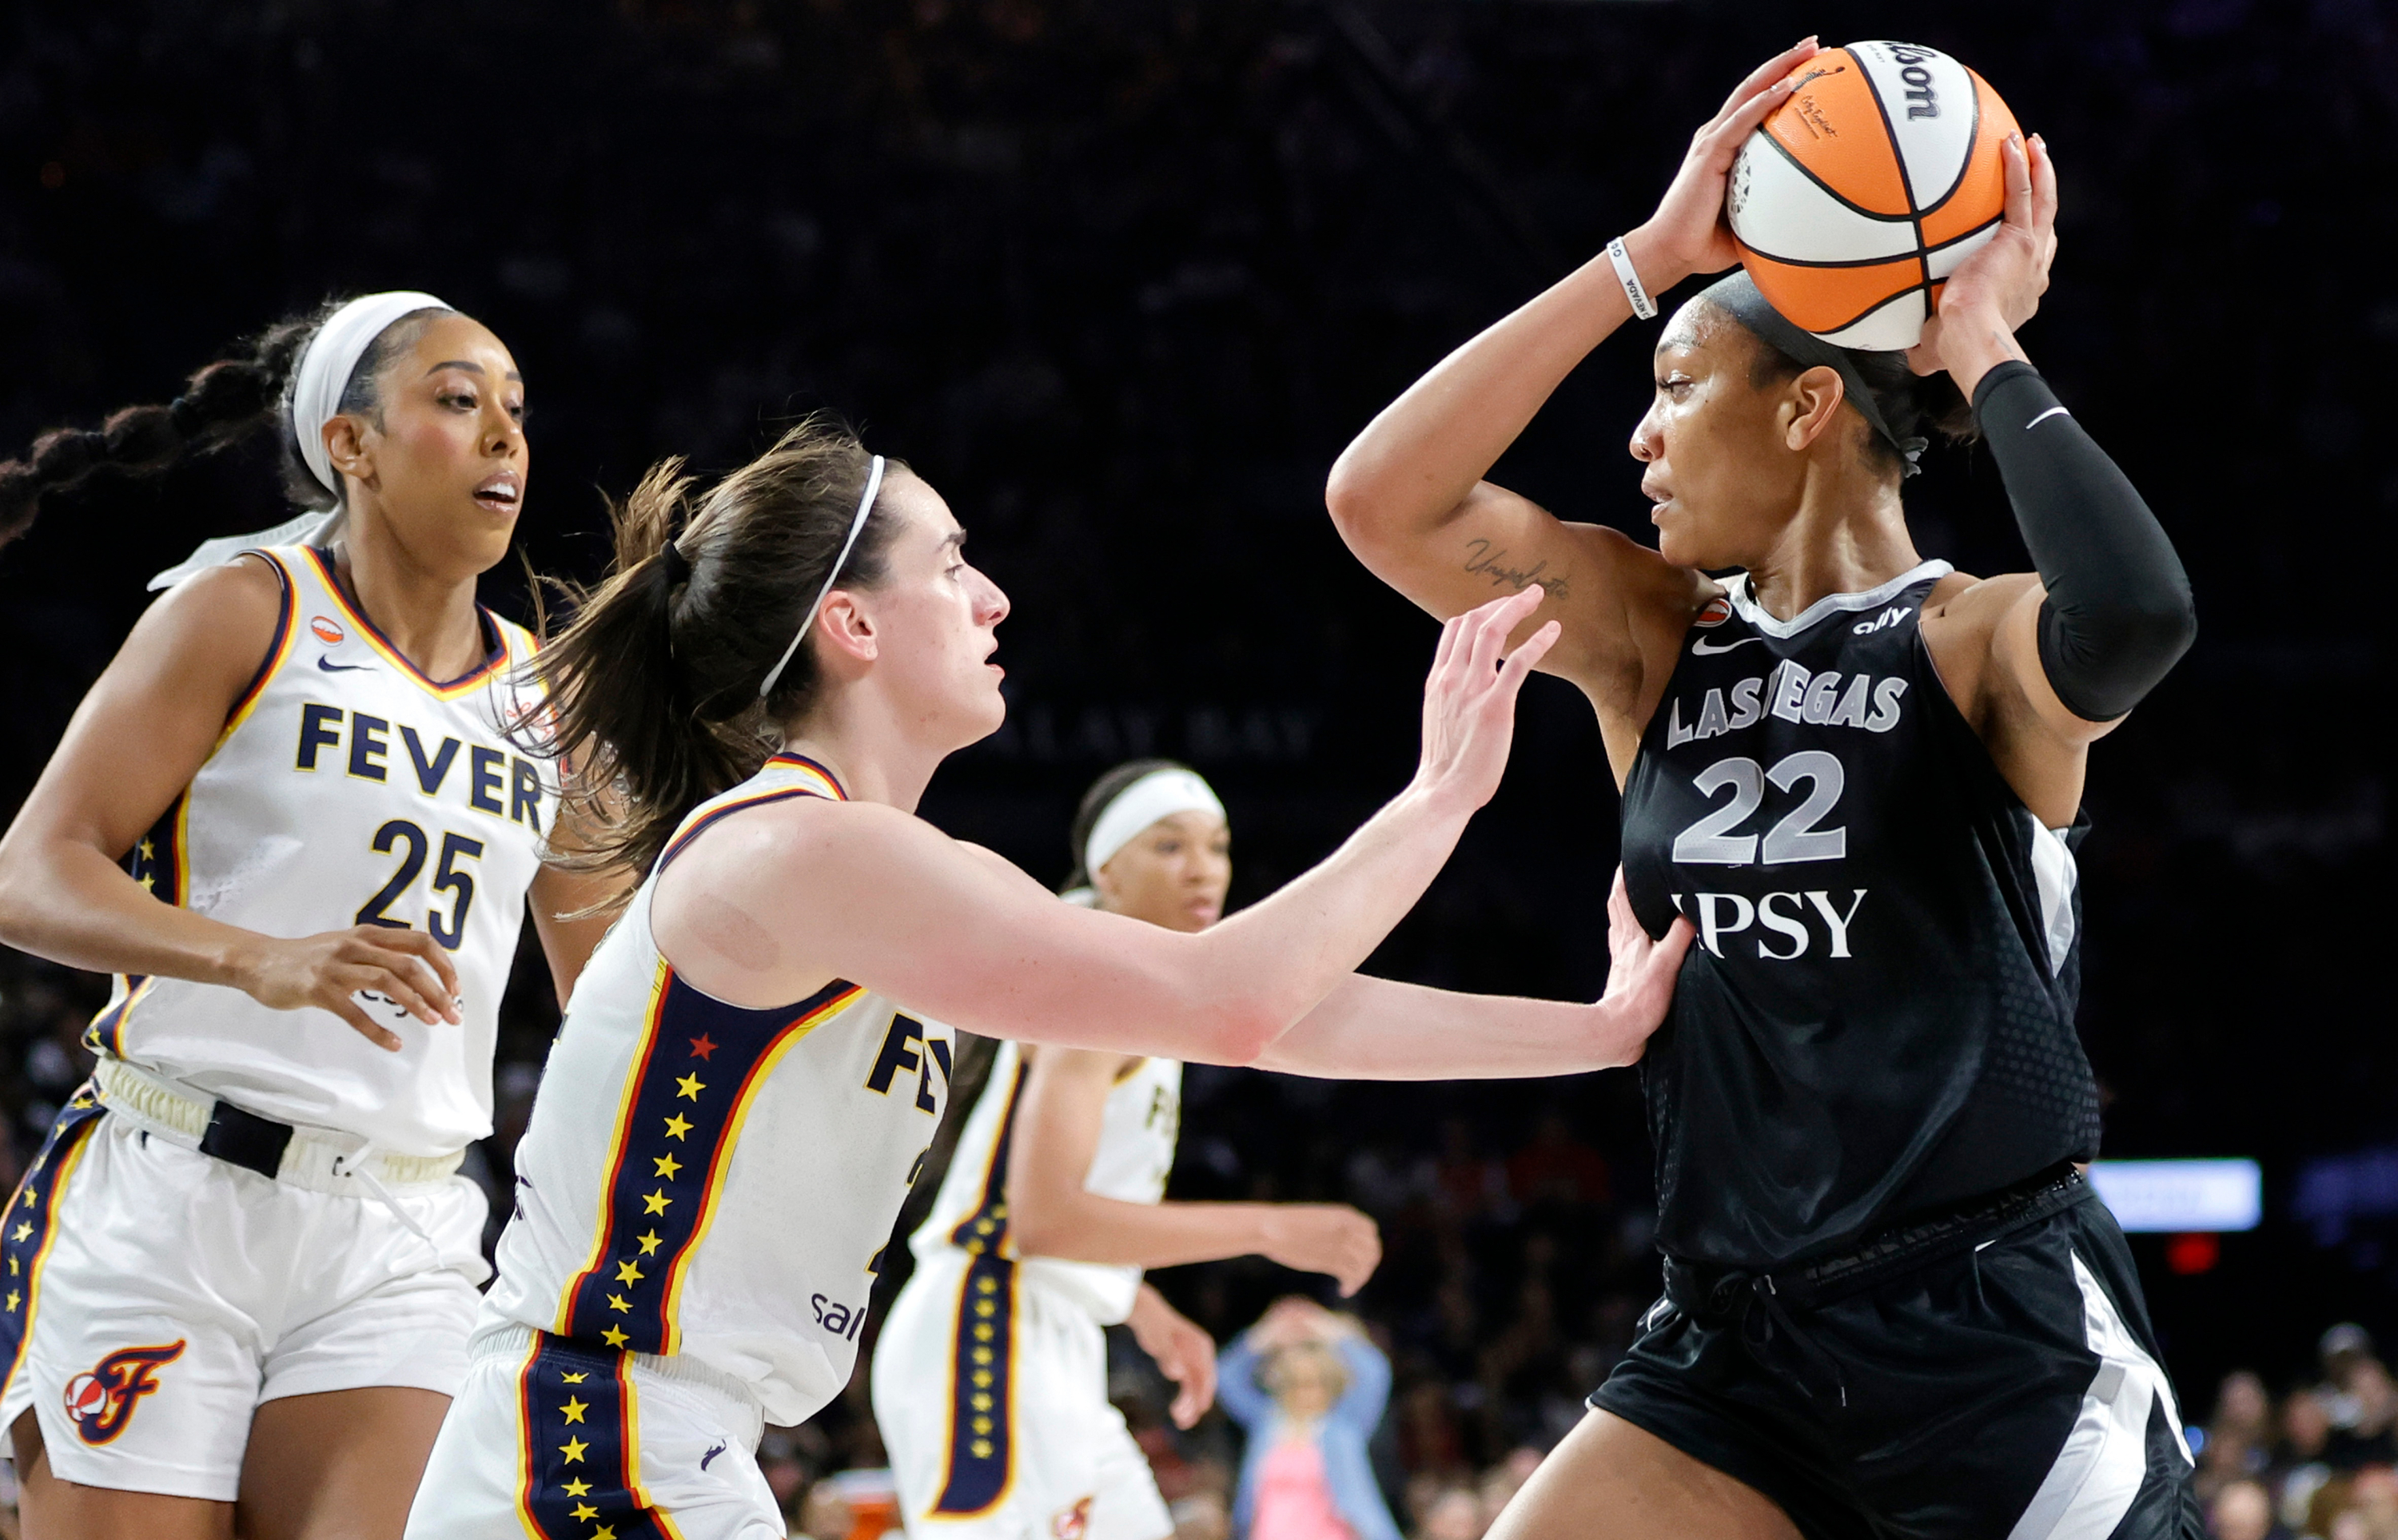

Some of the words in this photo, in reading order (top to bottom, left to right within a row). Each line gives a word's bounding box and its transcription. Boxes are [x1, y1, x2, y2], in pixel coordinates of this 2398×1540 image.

[1882, 42, 1941, 121] lson
[1627, 278, 1647, 313] NEVADA
[1852, 606, 1913, 635] ally
[1667, 676, 1763, 751] LAS
[293, 702, 543, 838] FEVER
[1672, 750, 1846, 865] 22
[353, 818, 486, 952] 25
[811, 1292, 866, 1343] sal
